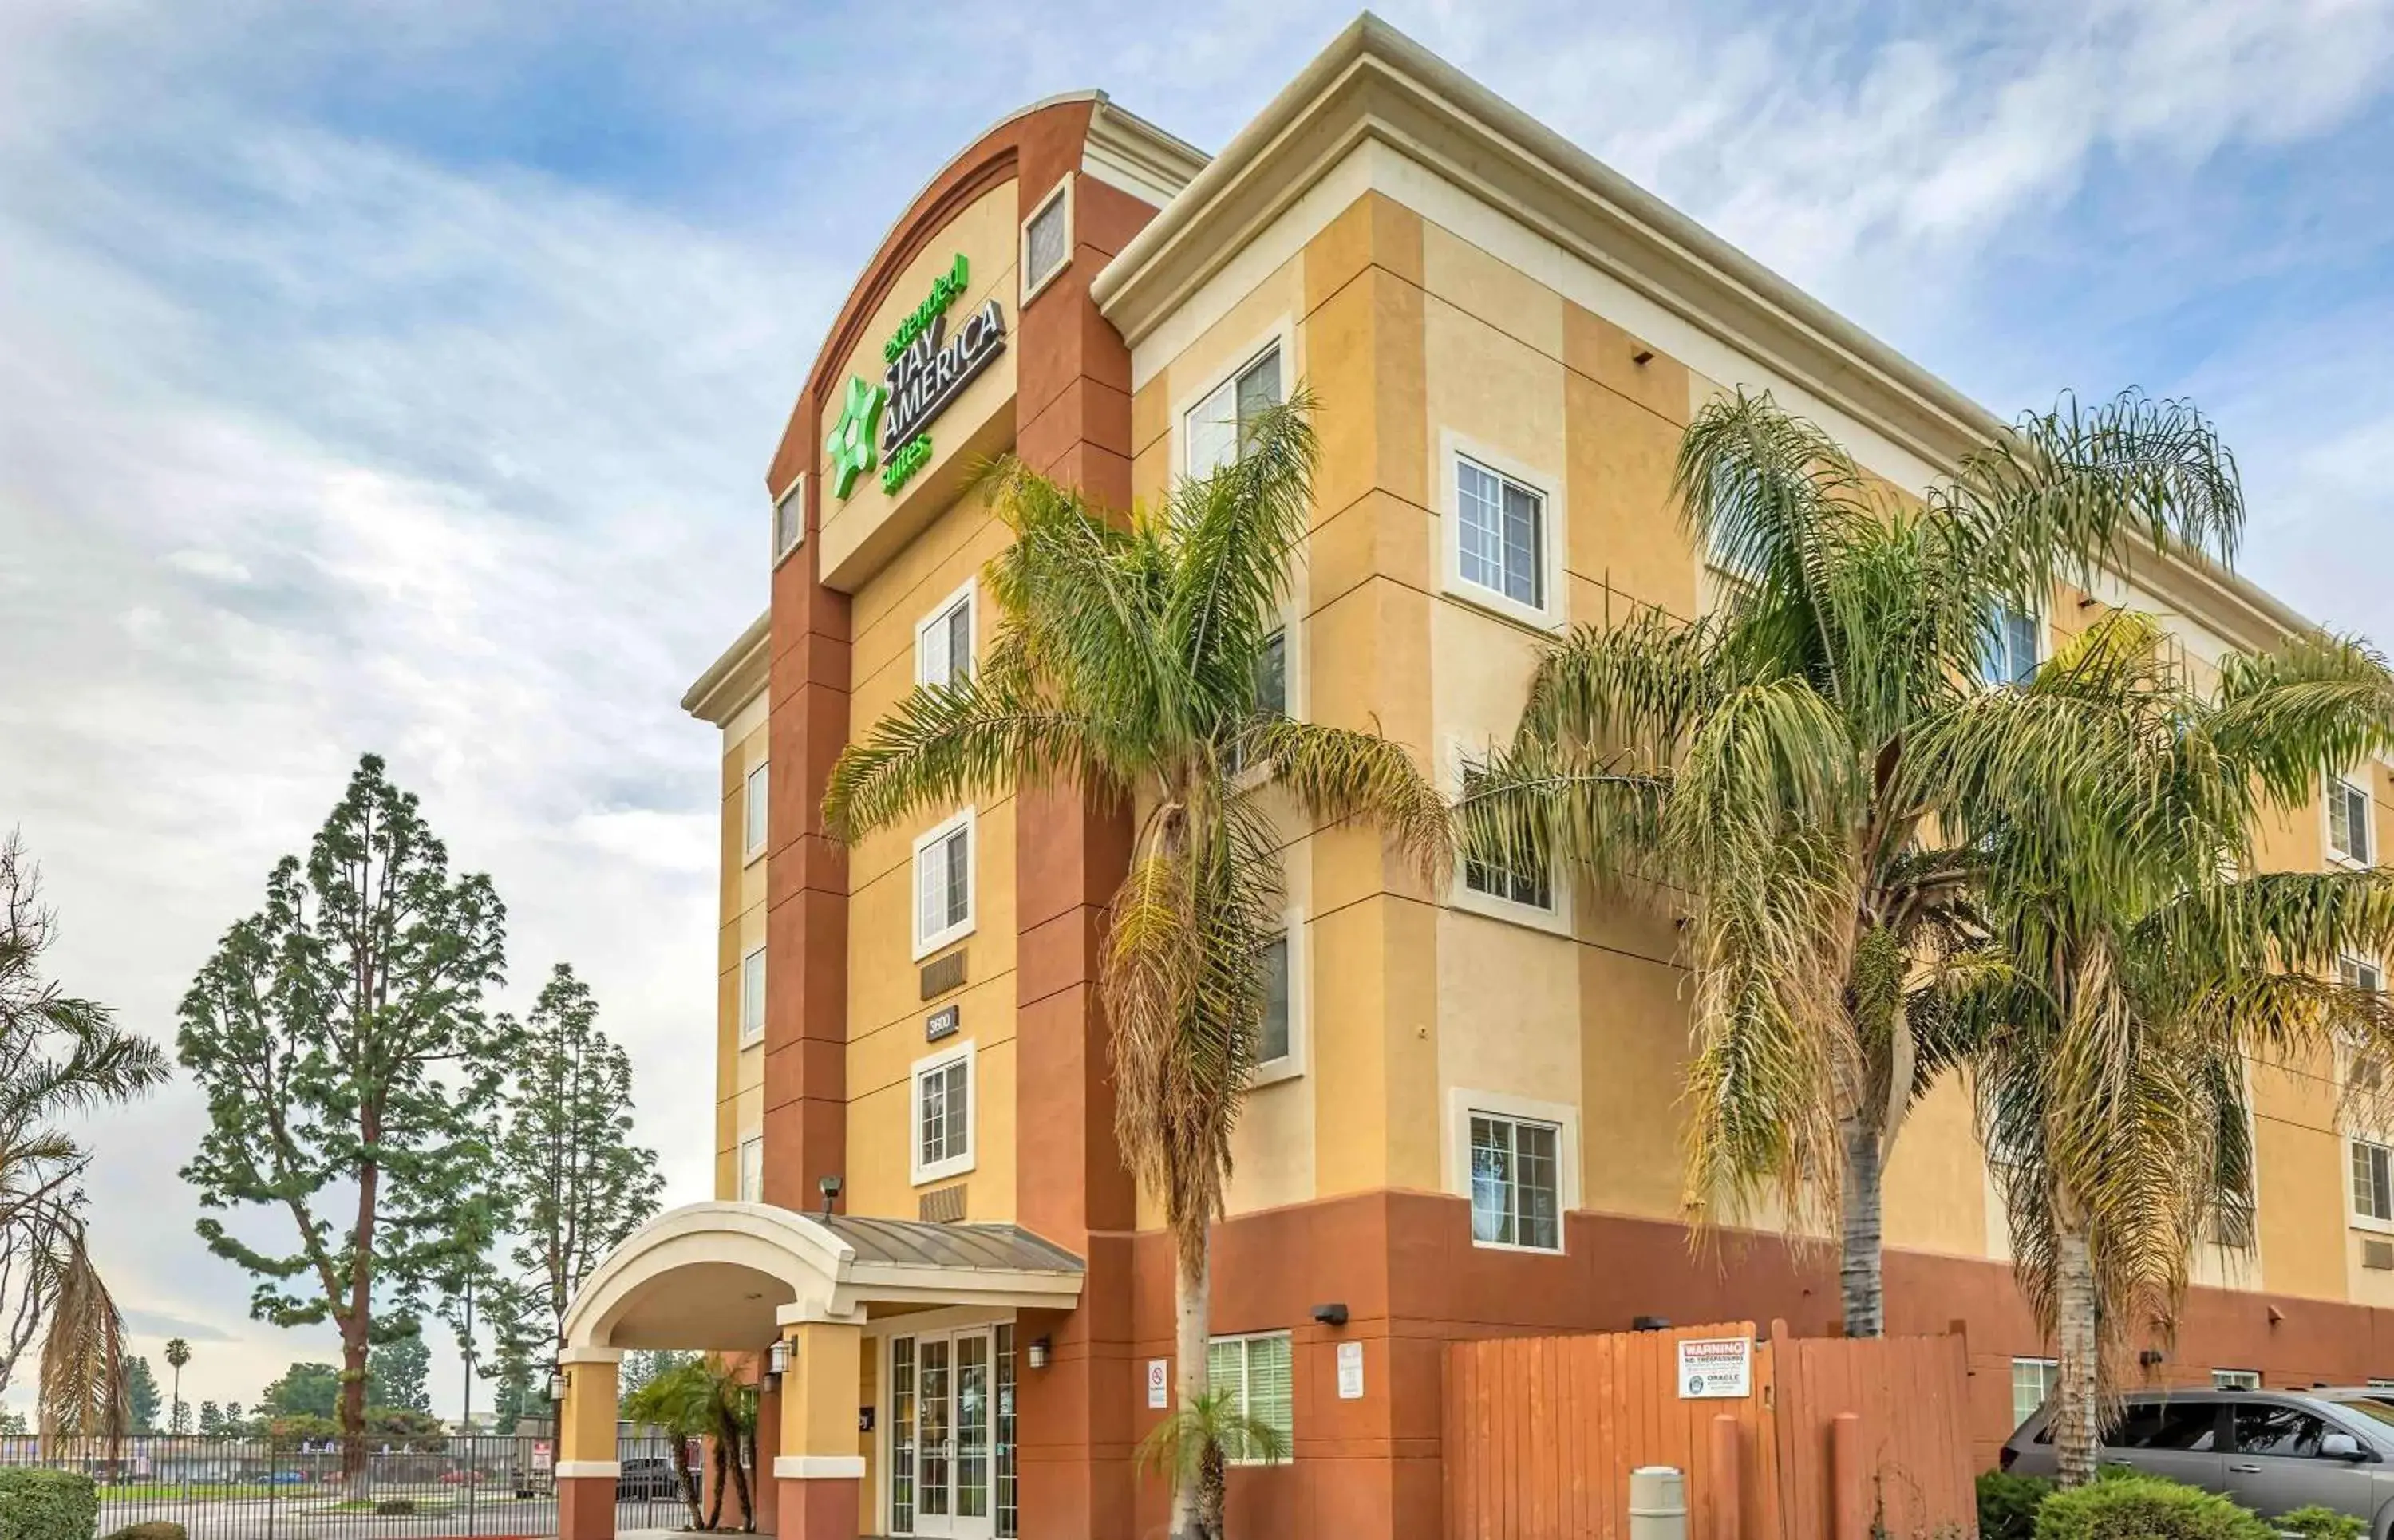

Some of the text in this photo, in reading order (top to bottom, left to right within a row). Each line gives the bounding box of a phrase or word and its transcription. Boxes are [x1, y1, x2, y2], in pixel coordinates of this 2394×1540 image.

[883, 253, 968, 364] extended
[883, 299, 1005, 448] AMERICA
[884, 315, 943, 407] STAY
[881, 433, 932, 496] suites
[1685, 1342, 1743, 1356] WARNING
